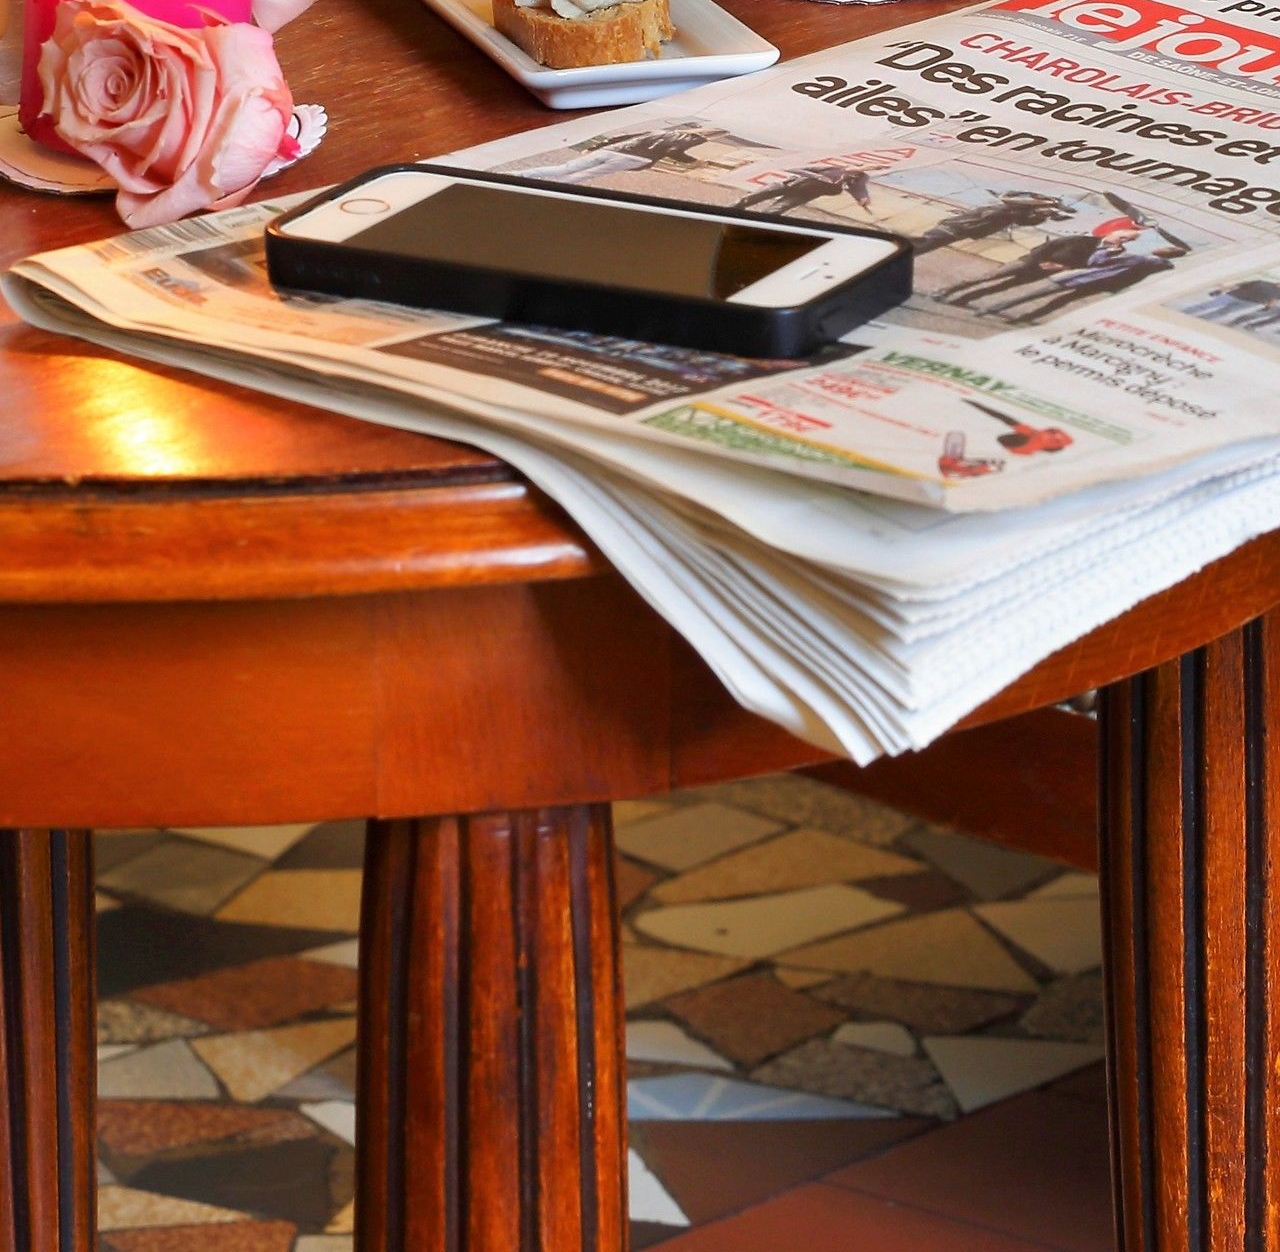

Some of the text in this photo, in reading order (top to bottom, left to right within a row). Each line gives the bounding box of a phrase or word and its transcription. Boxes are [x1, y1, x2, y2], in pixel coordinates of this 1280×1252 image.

[1127, 51, 1157, 65] DE
[990, 85, 1228, 146] racines
[956, 125, 1049, 152] en
[1014, 345, 1040, 359] le
[1032, 355, 1124, 388] permis
[1060, 340, 1172, 387] Marcigny
